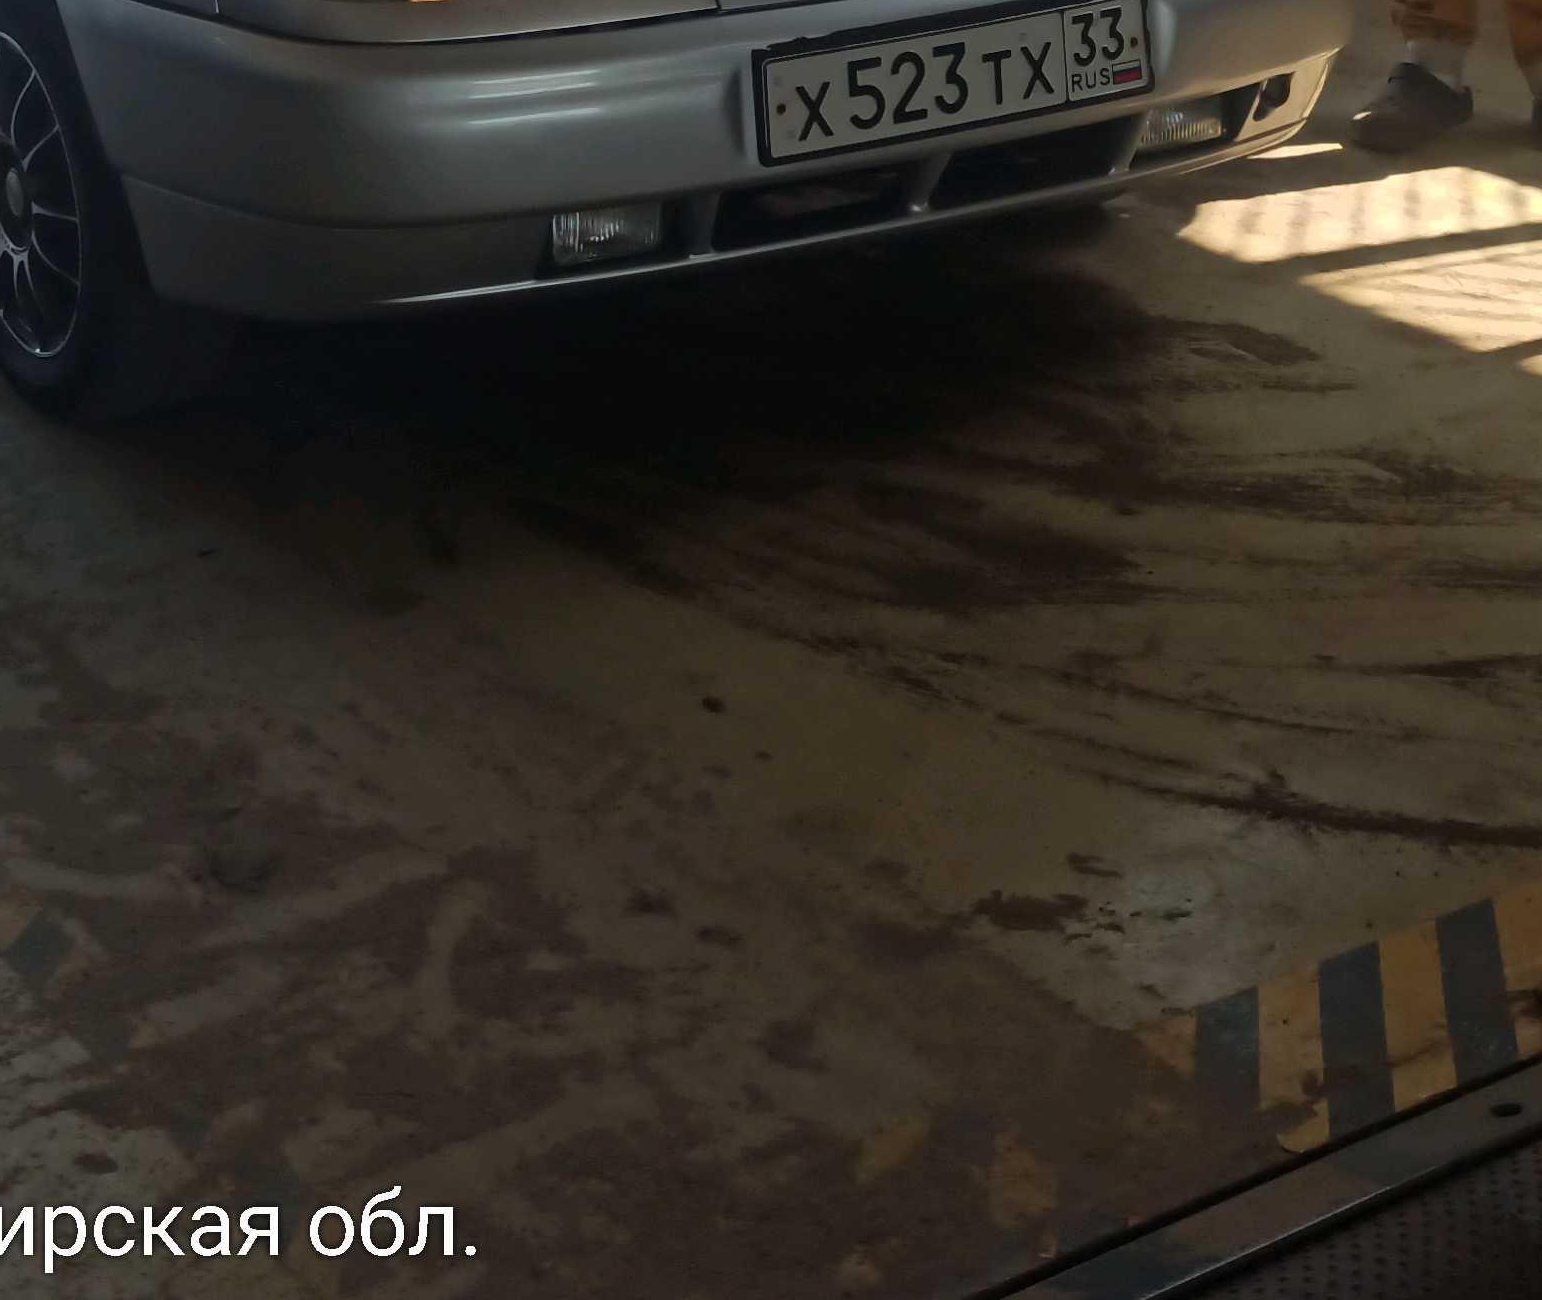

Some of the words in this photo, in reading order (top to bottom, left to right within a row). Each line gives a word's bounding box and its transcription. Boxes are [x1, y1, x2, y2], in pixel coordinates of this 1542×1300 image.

[1070, 6, 1125, 67] 33
[795, 41, 1055, 142] Х523ТХ
[1070, 67, 1111, 93] RUS
